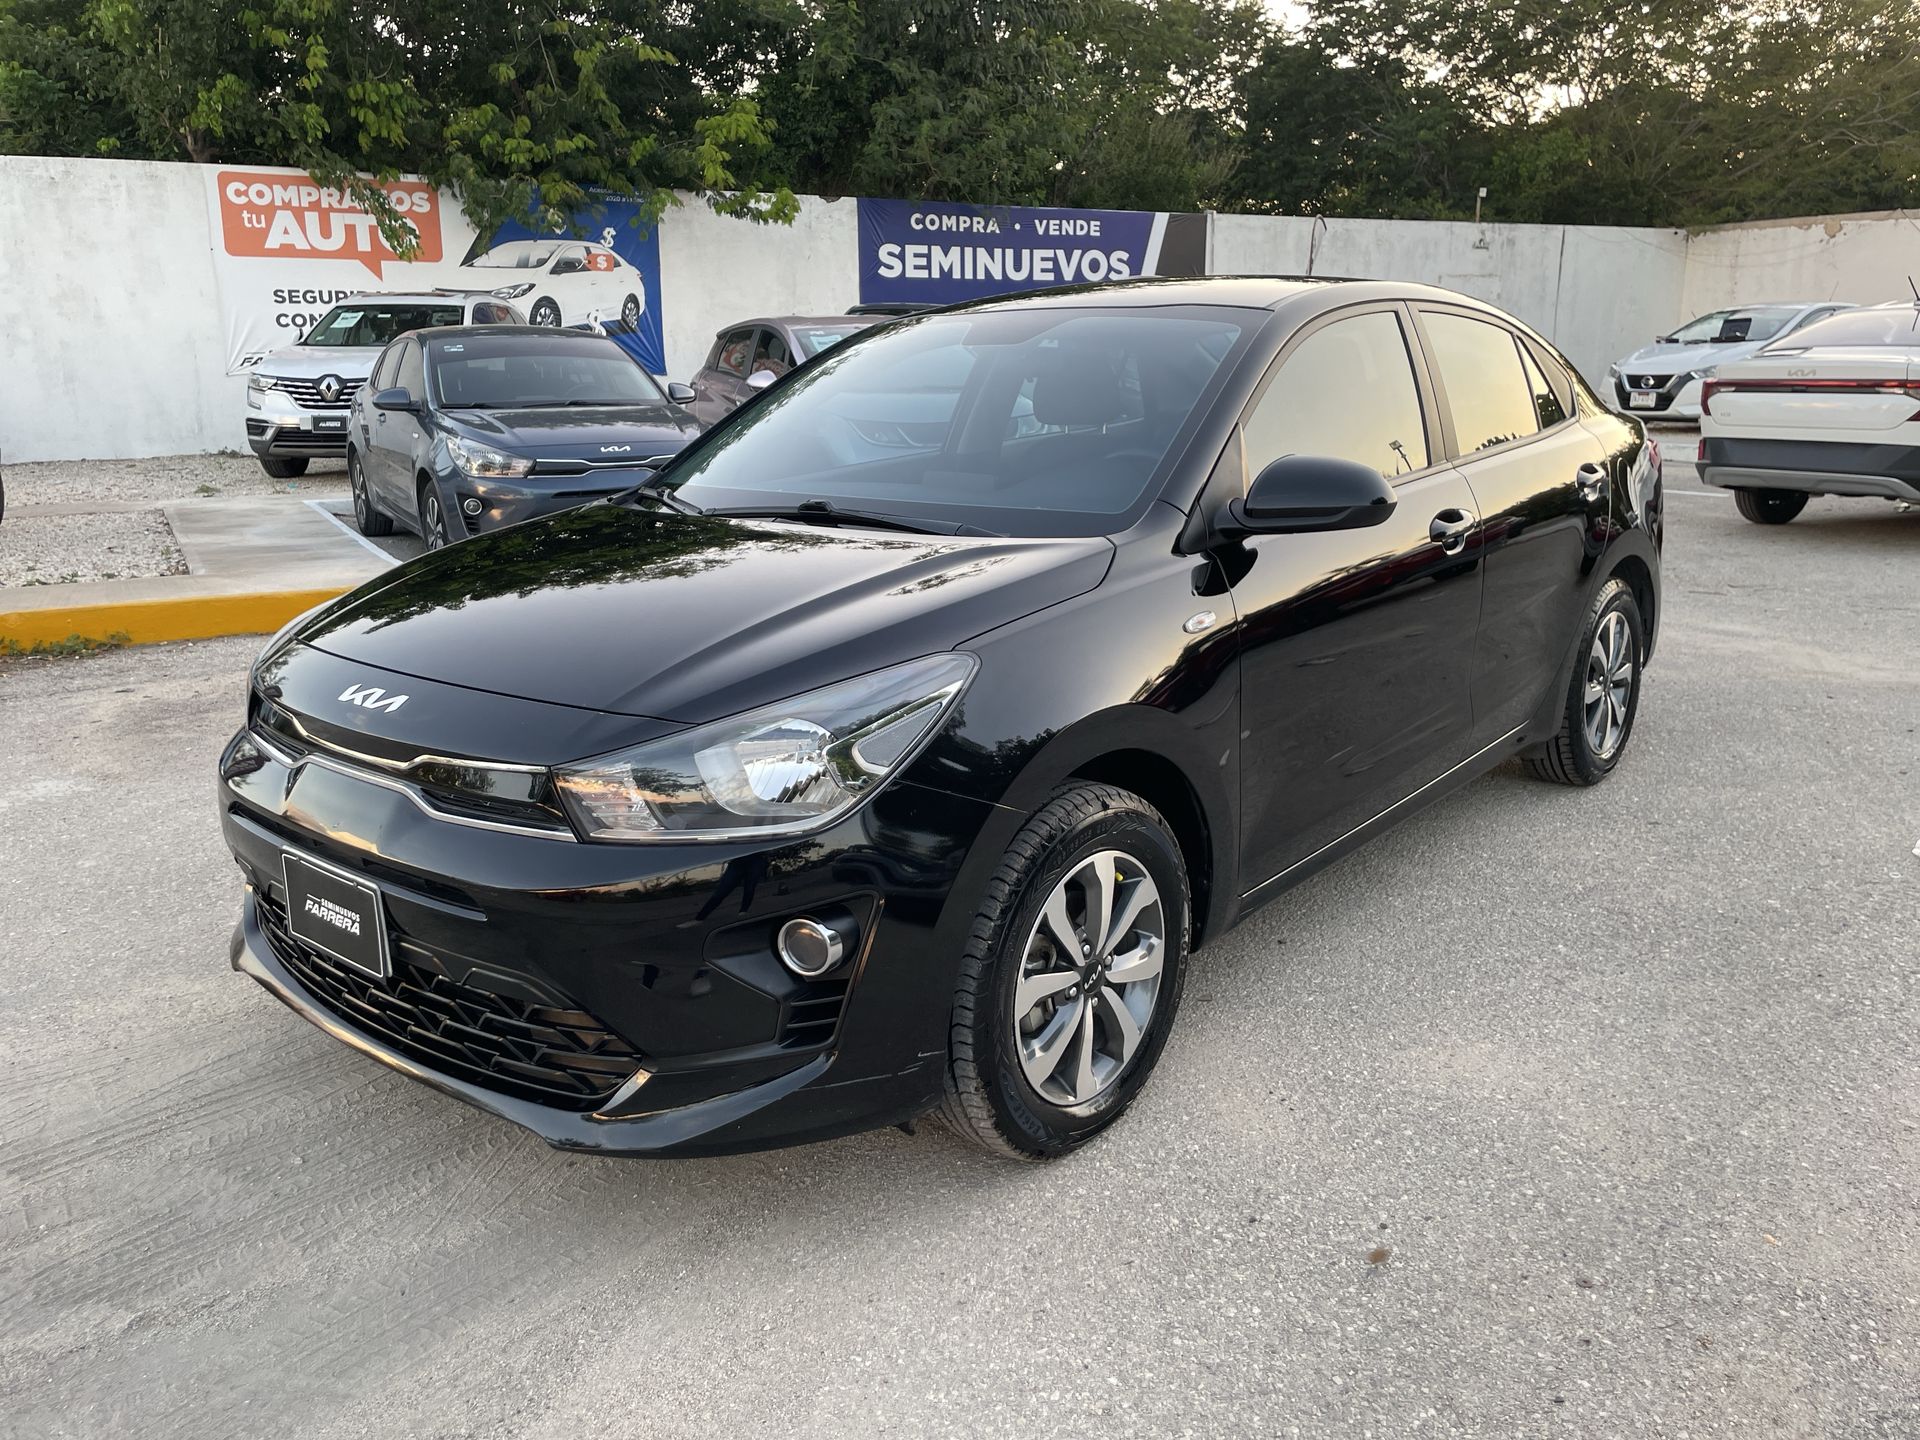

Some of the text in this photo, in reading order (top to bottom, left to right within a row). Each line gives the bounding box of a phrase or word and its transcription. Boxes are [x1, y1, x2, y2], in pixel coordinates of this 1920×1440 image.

[226, 181, 431, 214] COMPRAOS
[242, 210, 266, 228] tu
[910, 213, 1101, 237] COMPRA VENDE
[877, 243, 1131, 281] SEMINUEVOS
[337, 683, 409, 713] KIA
[304, 899, 361, 936] FARRERA
